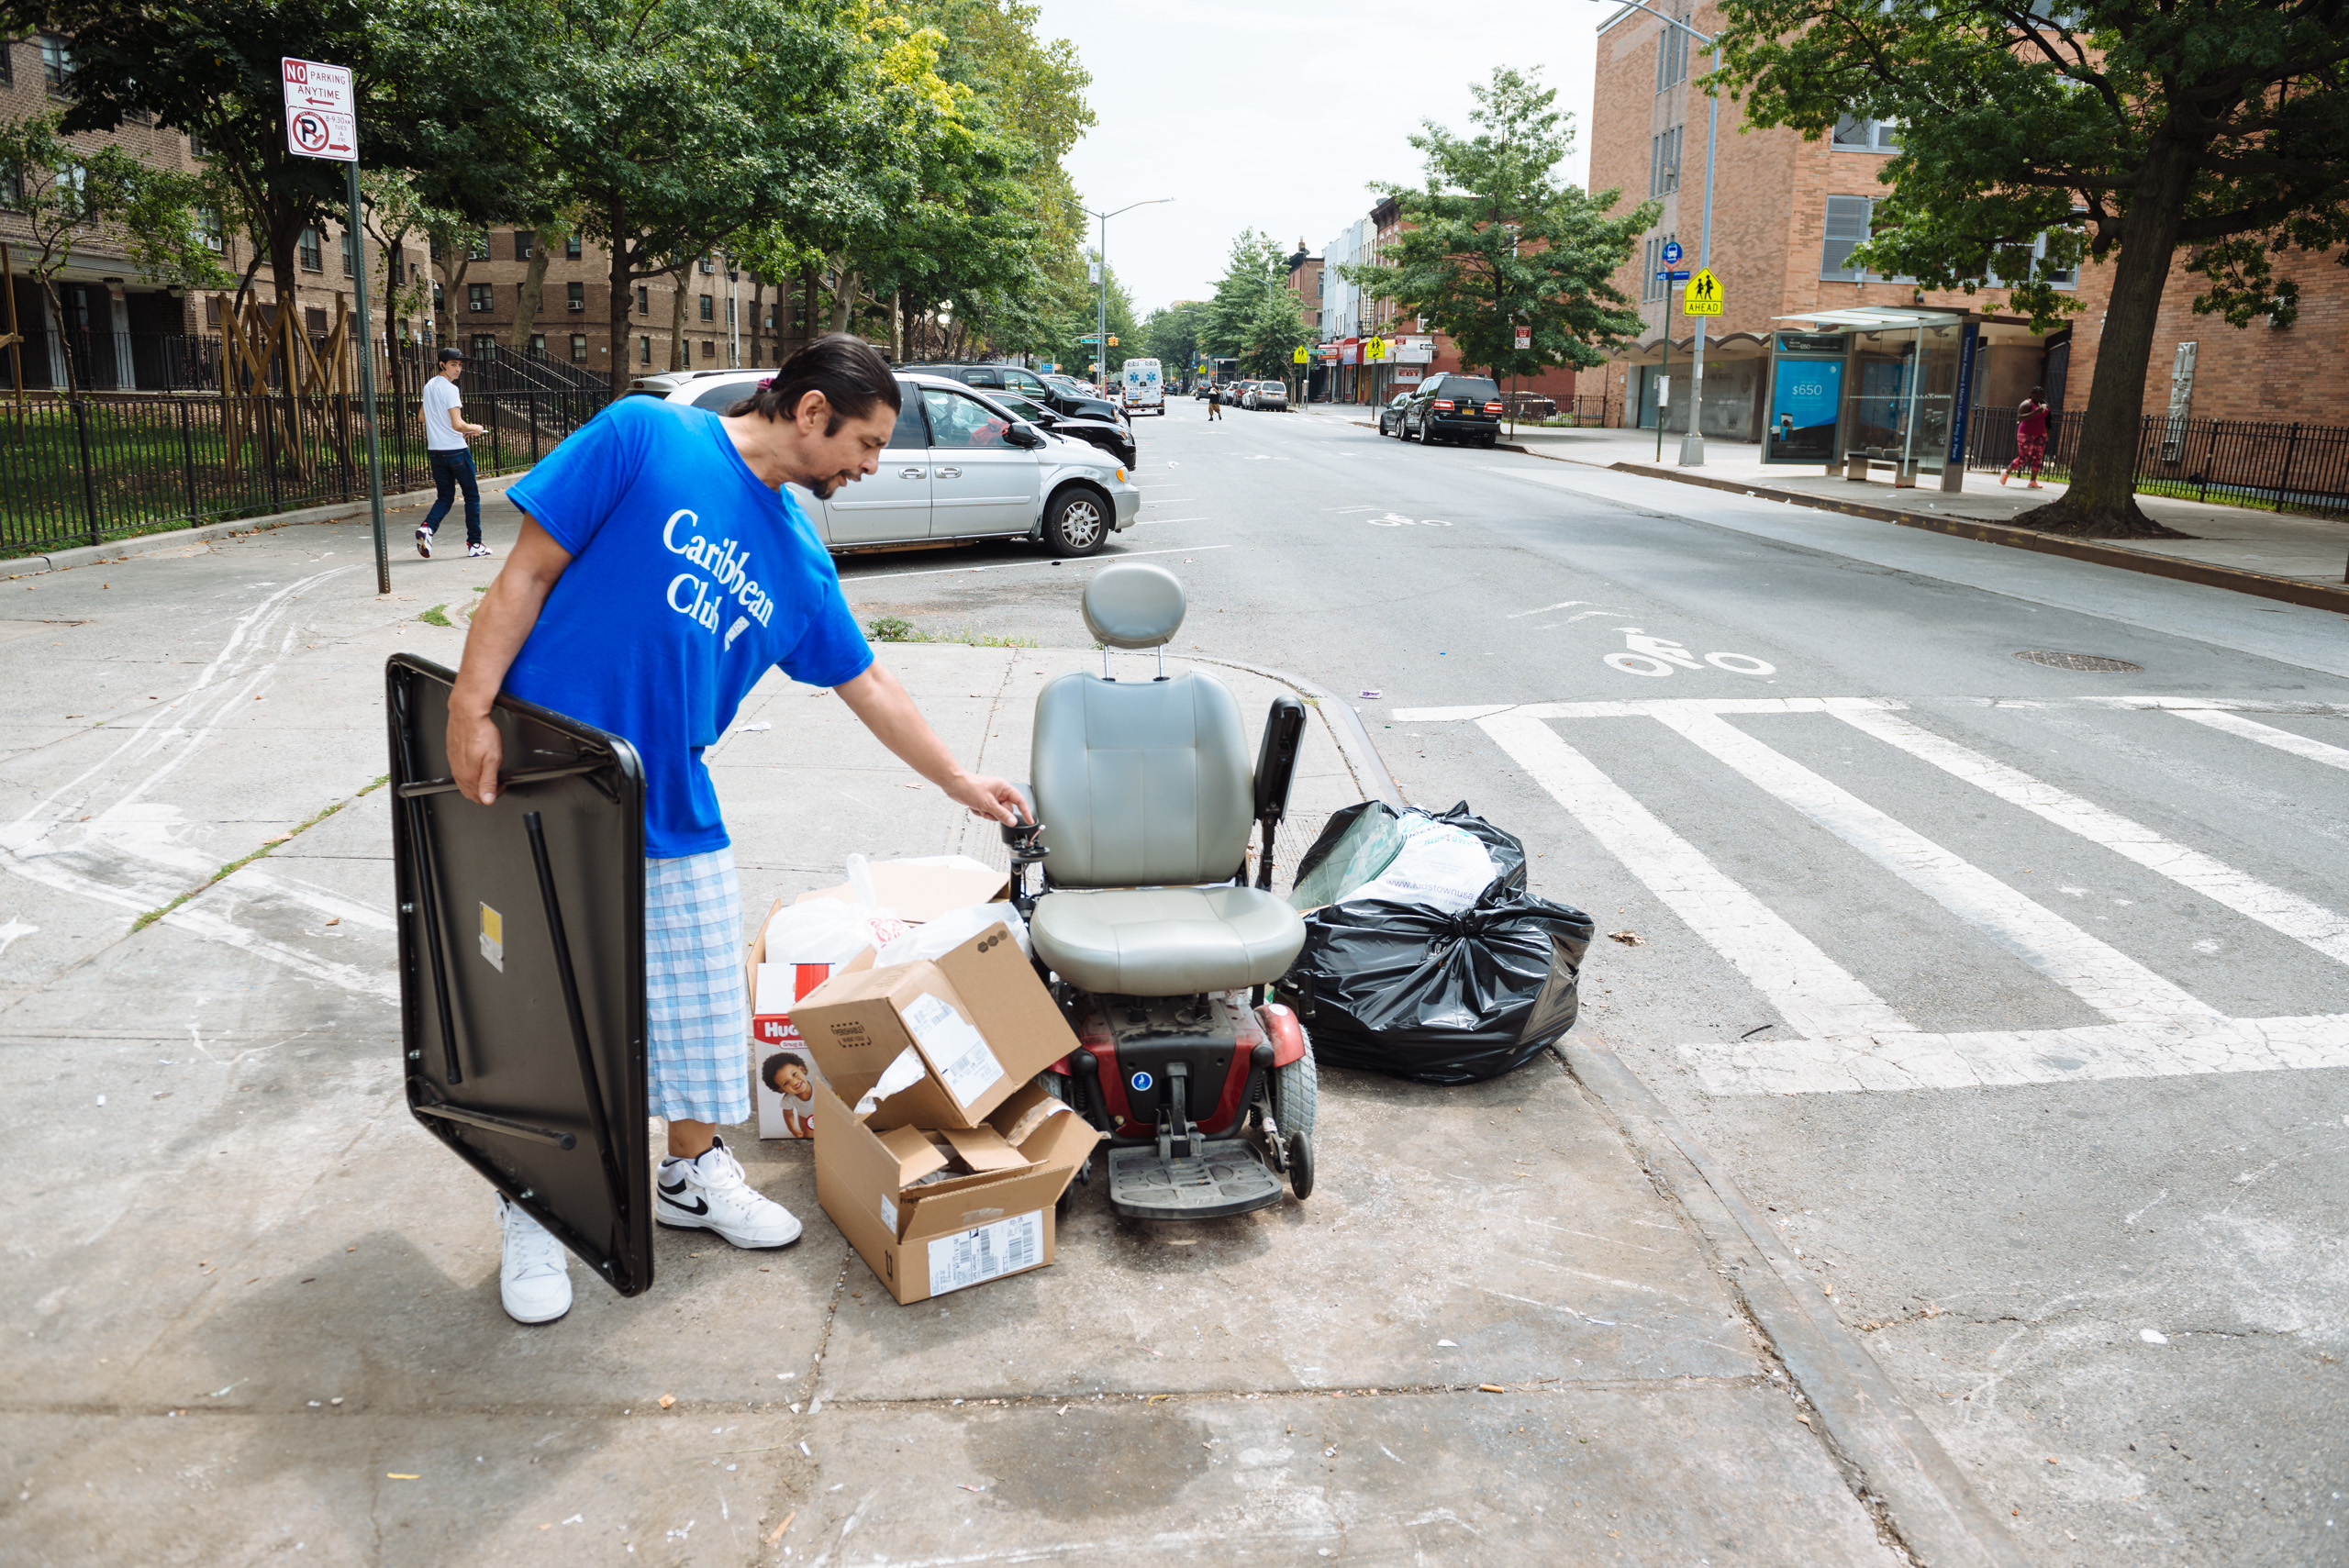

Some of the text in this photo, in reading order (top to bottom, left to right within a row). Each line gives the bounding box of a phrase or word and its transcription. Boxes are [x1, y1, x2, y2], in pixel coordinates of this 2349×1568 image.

[285, 63, 346, 85] NO PARKING
[297, 85, 340, 100] ANYTIME
[1688, 303, 1719, 312] AHEAD
[1792, 384, 1822, 395] $650
[662, 508, 774, 628] Caribbean
[666, 573, 722, 635] Club
[1386, 879, 1476, 901] www.kidstownusa.
